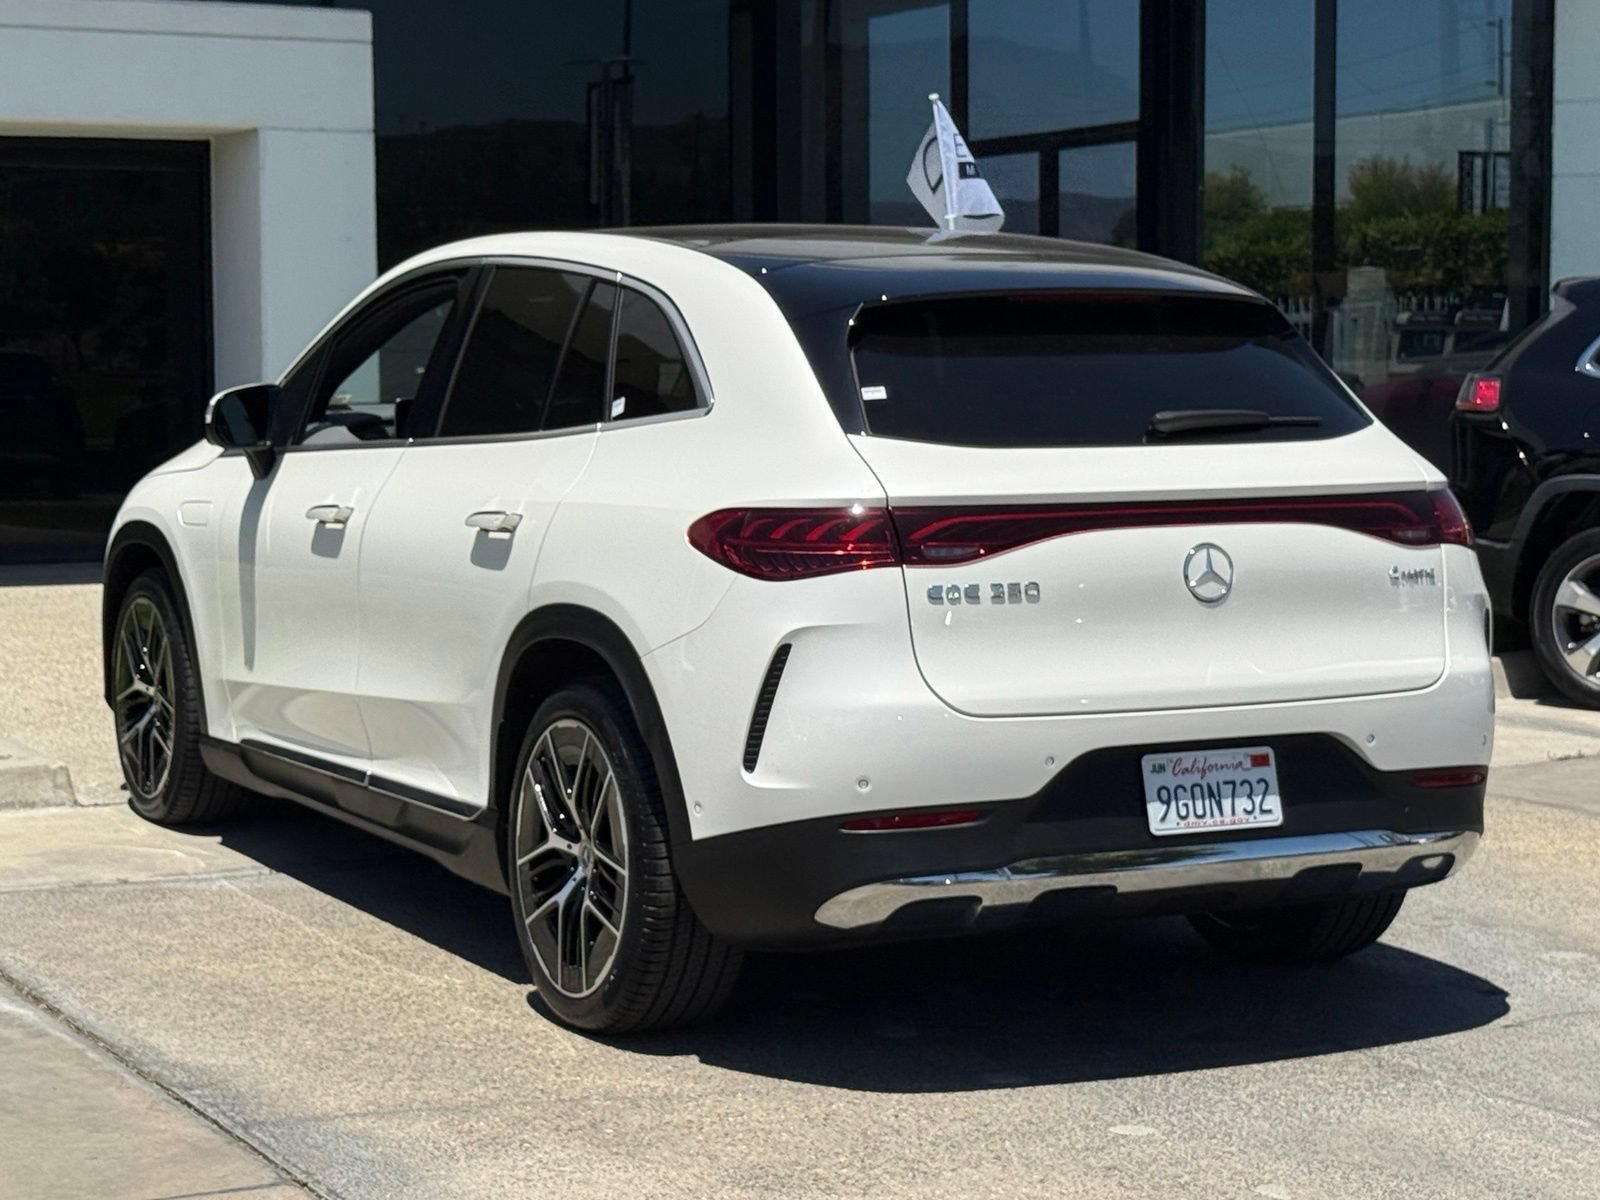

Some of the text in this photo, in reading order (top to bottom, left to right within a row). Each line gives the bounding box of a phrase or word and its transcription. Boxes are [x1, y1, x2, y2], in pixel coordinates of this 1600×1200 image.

[927, 581, 1041, 605] EQE 350
[1171, 756, 1247, 779] California
